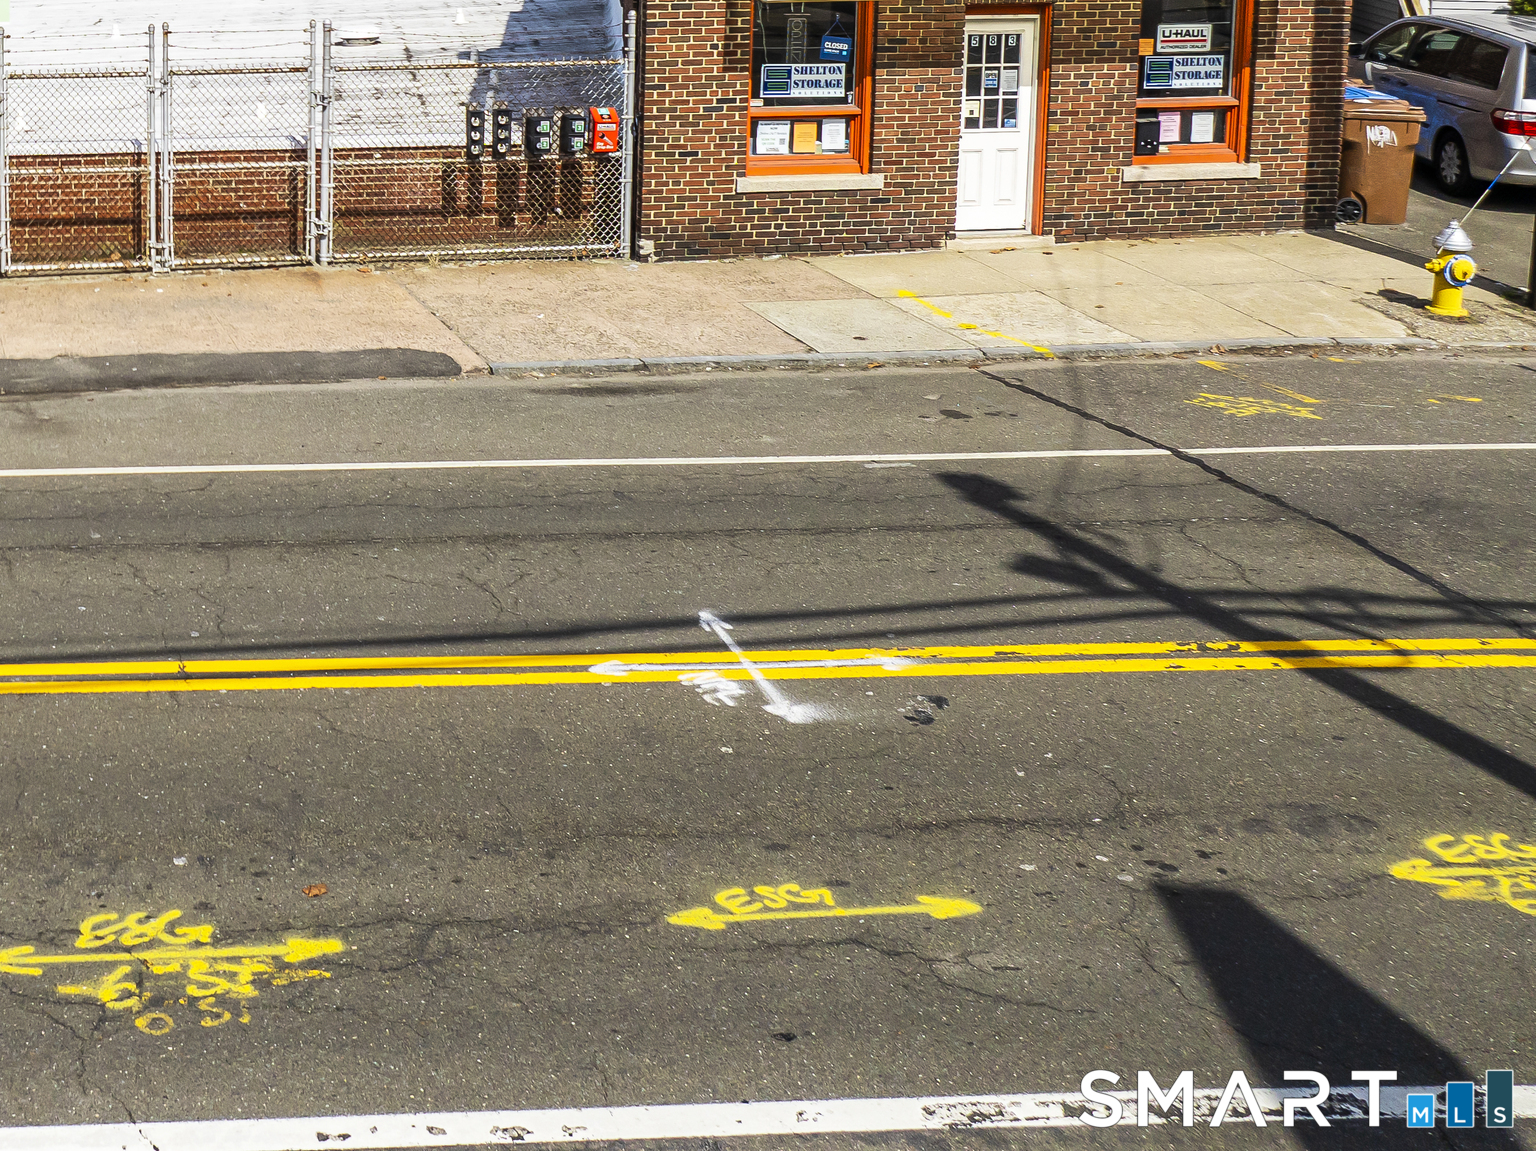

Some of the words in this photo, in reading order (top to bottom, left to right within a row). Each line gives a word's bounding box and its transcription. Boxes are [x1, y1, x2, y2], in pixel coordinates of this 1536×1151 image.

[1162, 29, 1207, 38] U-HAUL
[824, 41, 849, 50] CLOSED
[1175, 57, 1223, 67] SHELTON
[793, 65, 843, 76] SHELTON
[1174, 70, 1222, 80] STORAGE
[793, 79, 843, 89] STORAGE
